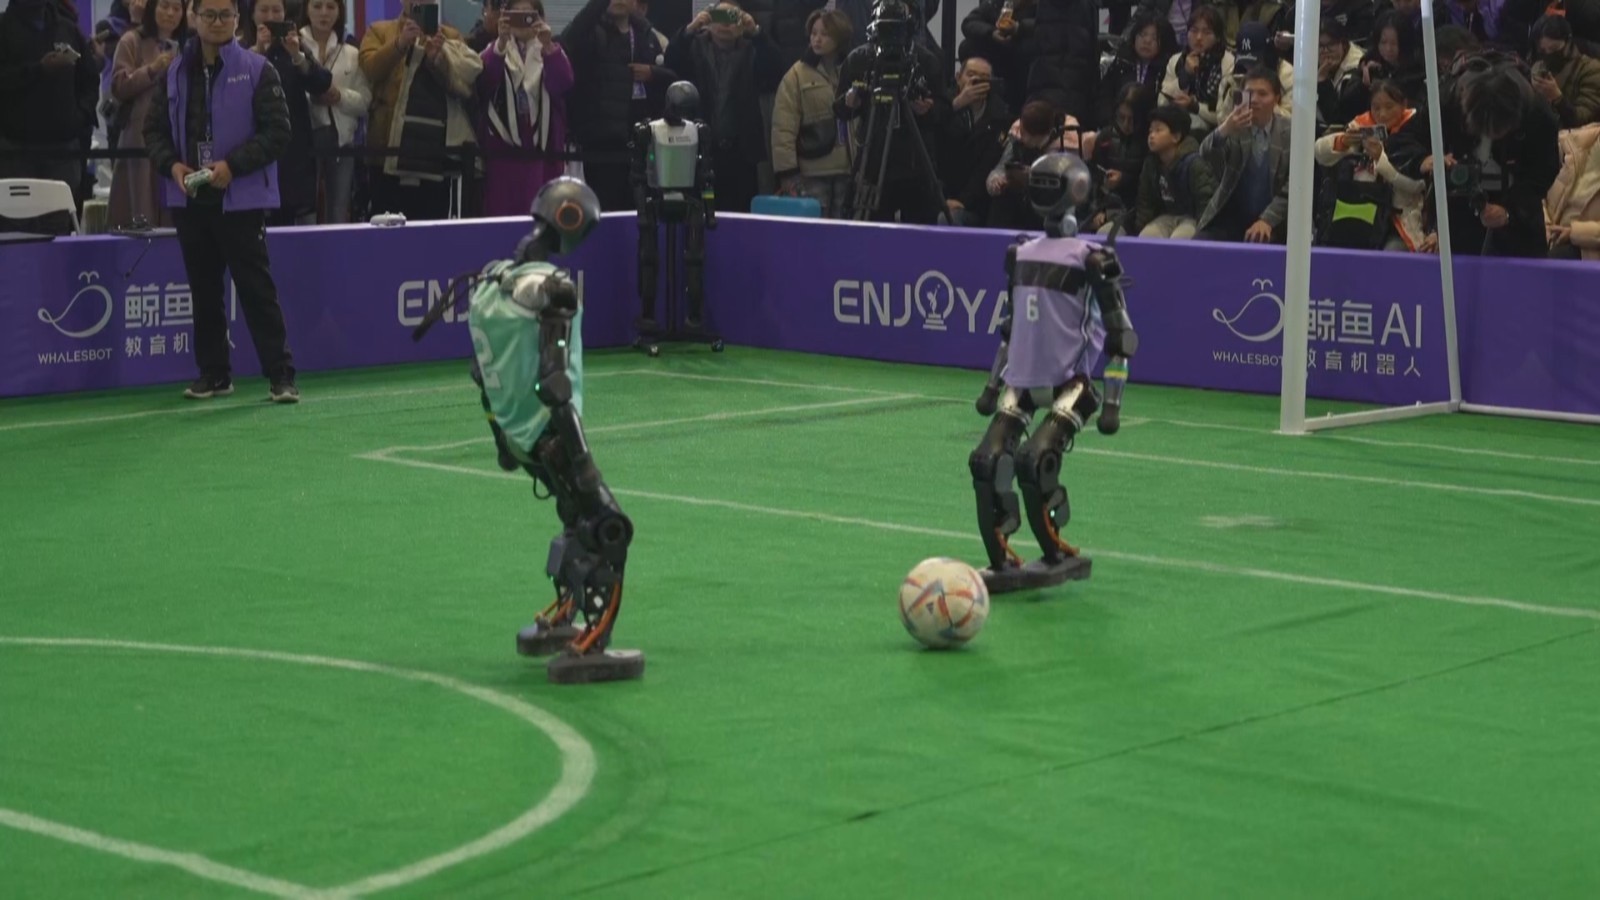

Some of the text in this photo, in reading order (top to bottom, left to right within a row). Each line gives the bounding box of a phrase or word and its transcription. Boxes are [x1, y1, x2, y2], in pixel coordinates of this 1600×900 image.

[833, 270, 1009, 334] ENJOYA
[1026, 294, 1039, 322] 6
[38, 348, 112, 365] WHALESBOT
